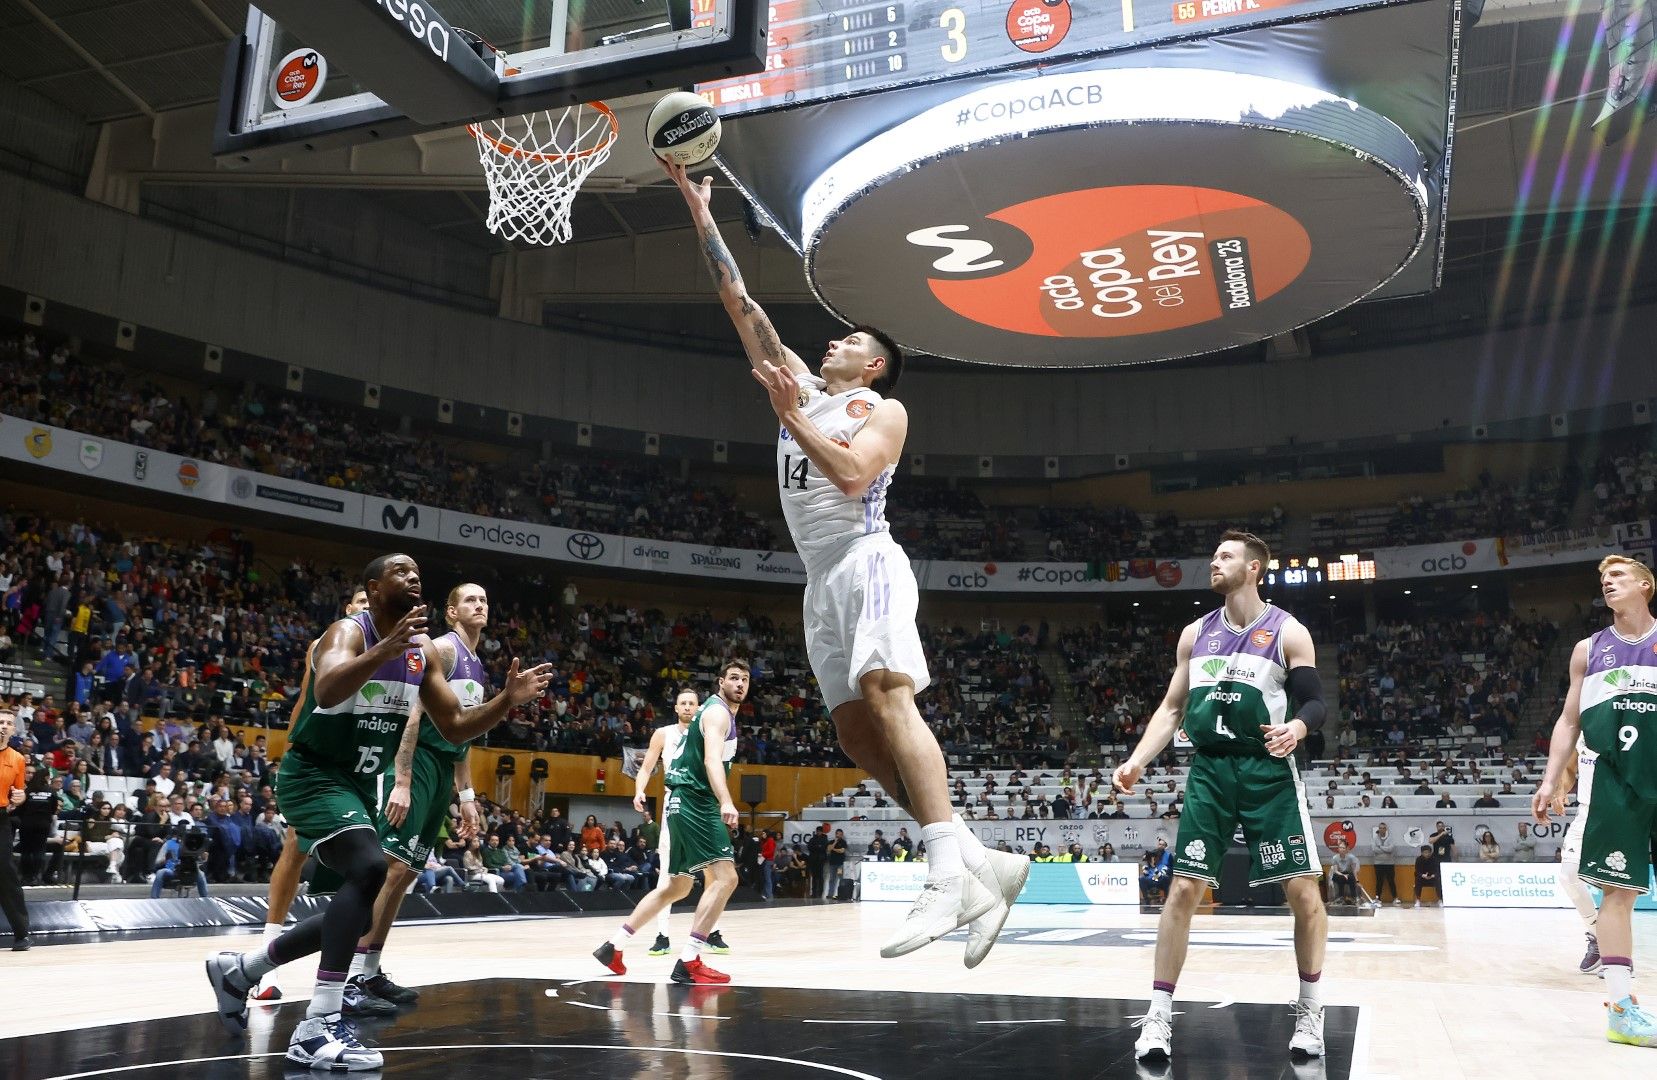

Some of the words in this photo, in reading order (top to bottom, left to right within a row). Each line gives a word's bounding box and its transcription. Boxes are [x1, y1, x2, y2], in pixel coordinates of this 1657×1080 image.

[887, 7, 896, 22] 5
[1017, 14, 1050, 27] Copa
[1178, 3, 1196, 20] 55
[377, 0, 449, 62] esa
[888, 31, 897, 47] 2
[940, 8, 967, 62] 3
[888, 54, 903, 72] 10
[956, 85, 1103, 127] #CopaACB
[663, 111, 713, 145] SPALDING
[1147, 230, 1205, 281] Rey
[1217, 239, 1242, 258] '23
[1080, 248, 1144, 318] Copa
[1224, 257, 1250, 309] Badalona
[1040, 275, 1085, 310] acb
[1148, 283, 1184, 307] del
[782, 454, 809, 490] 14
[459, 523, 541, 549] endesa
[633, 545, 670, 560] divina
[690, 552, 741, 570] SPALDING
[1421, 554, 1467, 573] acb
[947, 572, 988, 588] acb
[1017, 566, 1129, 584] #CopaB
[1629, 679, 1657, 690] Unica
[1618, 725, 1639, 752] 9
[354, 745, 384, 774] 15
[791, 829, 816, 845] ac
[981, 827, 1011, 841] DEL
[1016, 827, 1047, 842] REY
[1088, 874, 1128, 886] divina
[1470, 874, 1513, 886] Seguro
[1518, 873, 1556, 885] Salud
[1471, 887, 1555, 899] Especialistas
